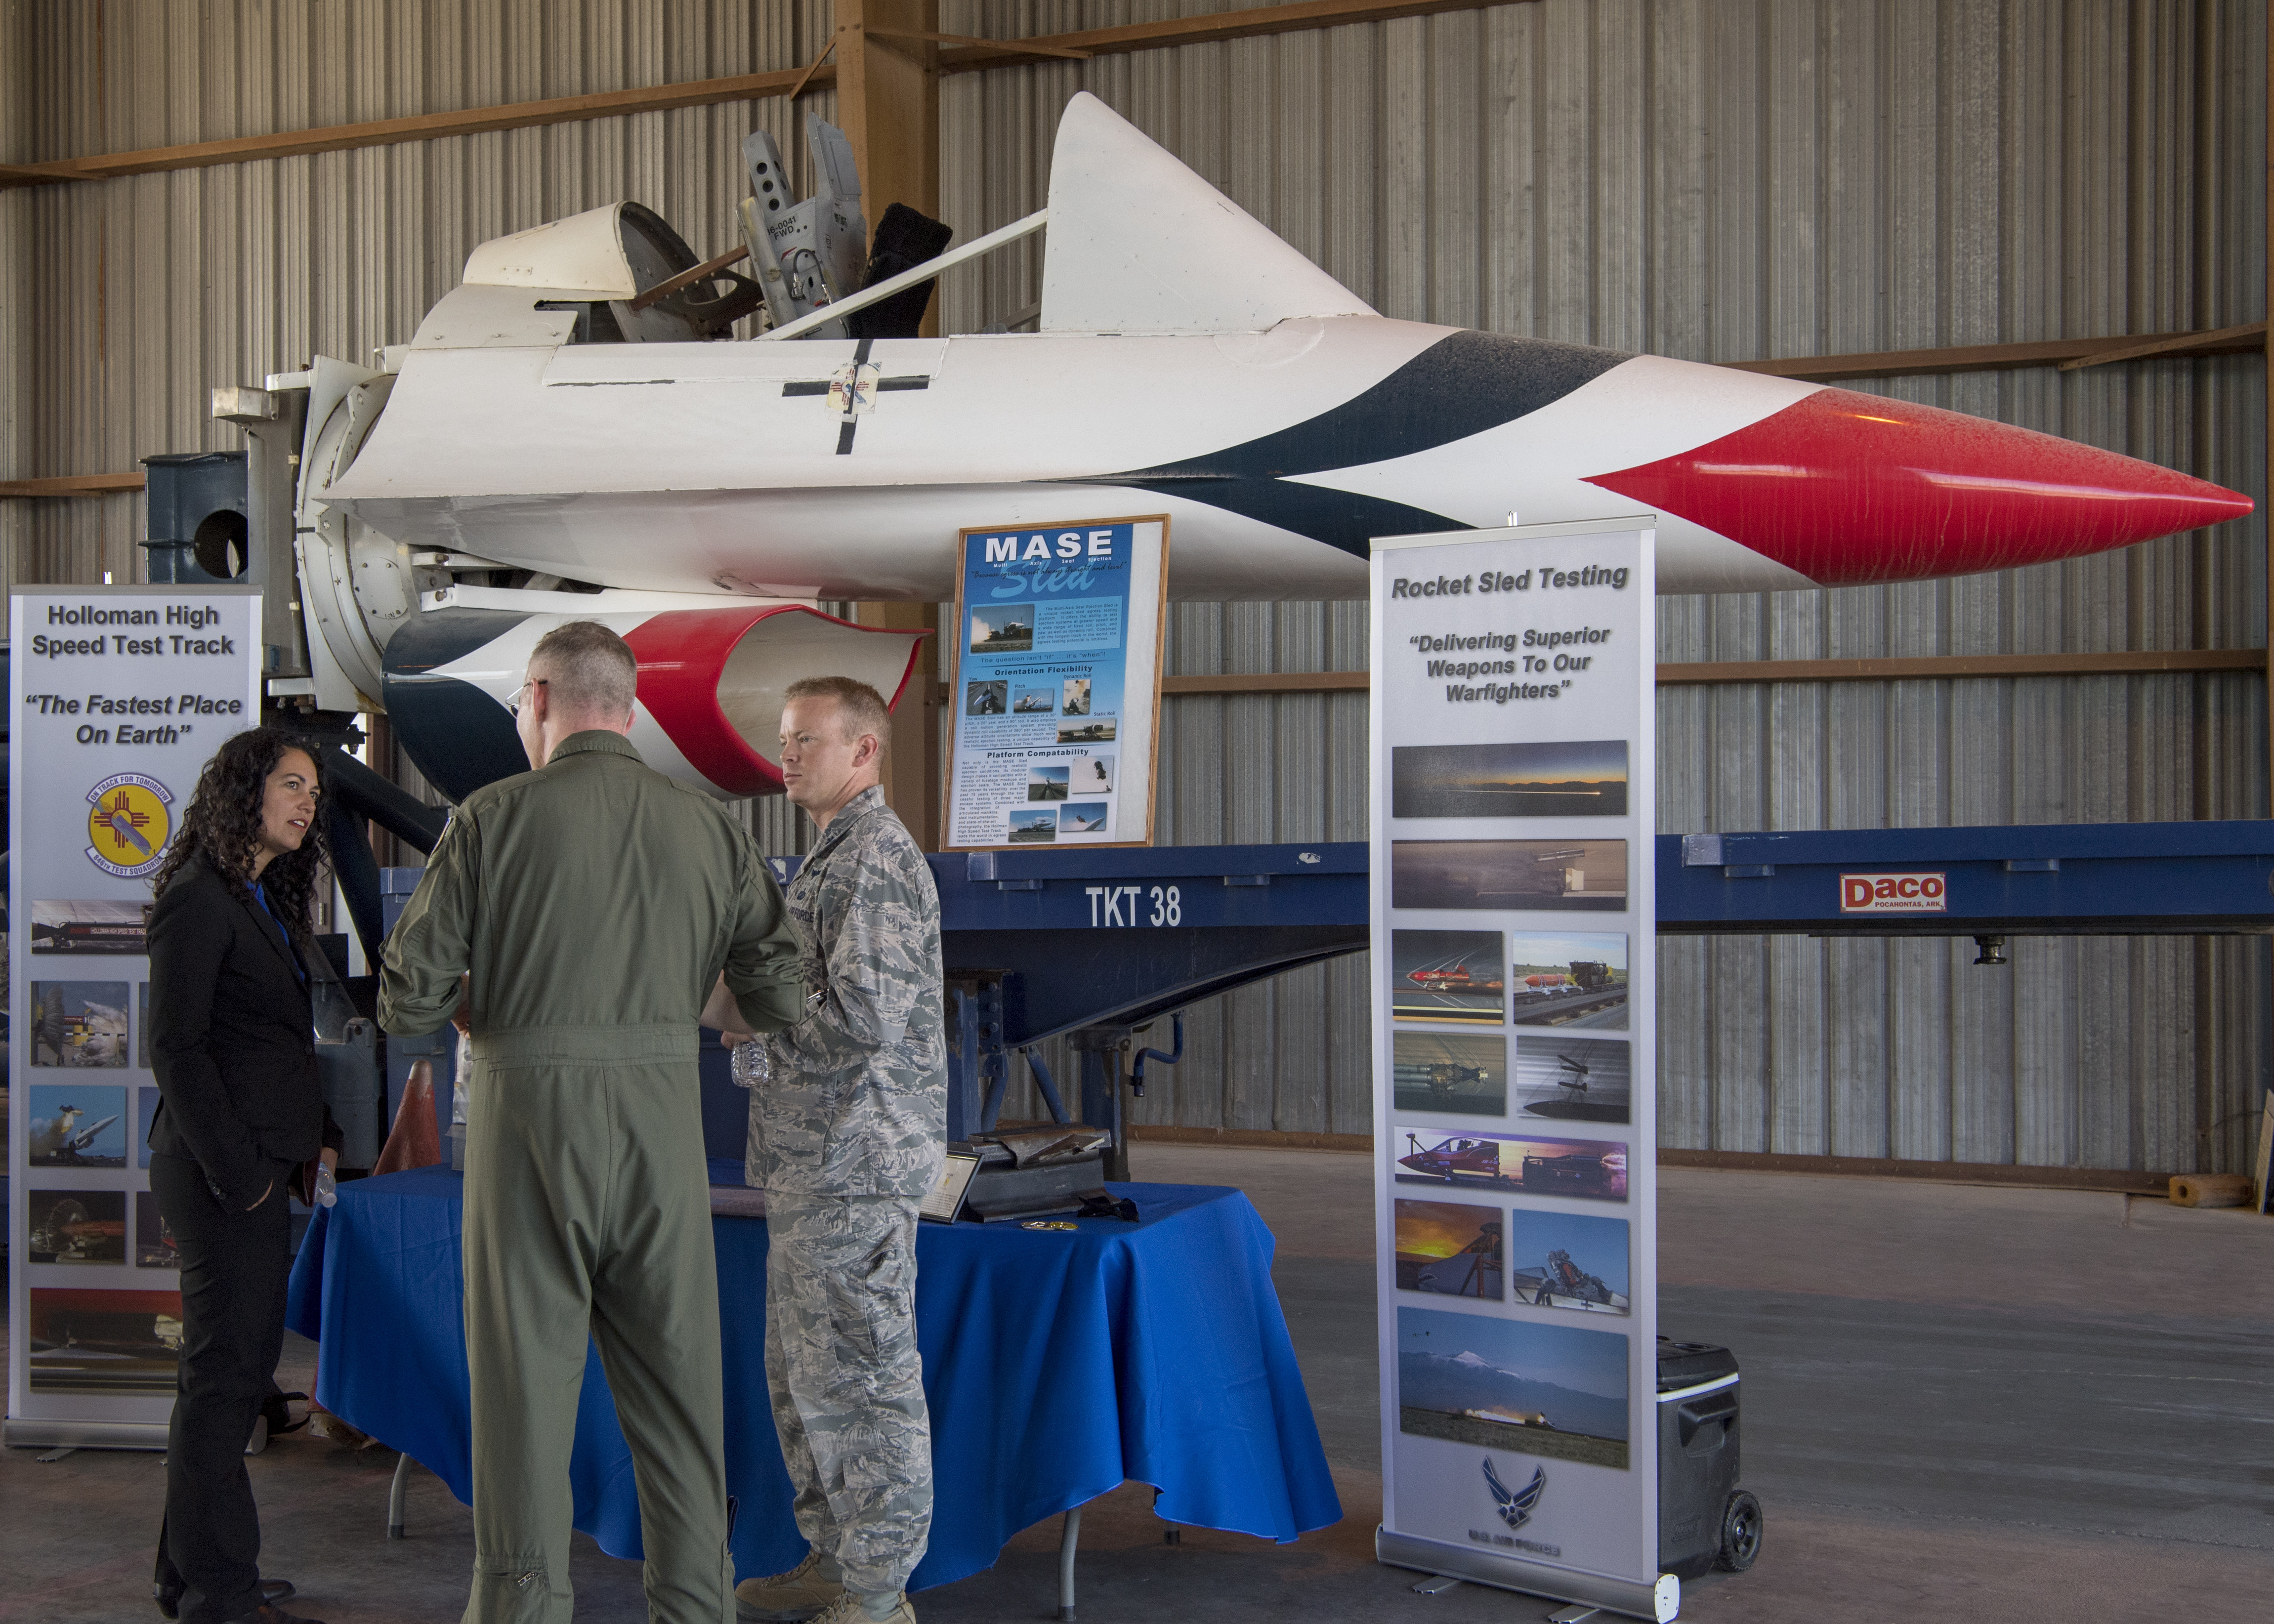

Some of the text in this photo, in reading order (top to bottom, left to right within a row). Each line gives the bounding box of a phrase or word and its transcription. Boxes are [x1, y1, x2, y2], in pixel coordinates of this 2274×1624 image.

[774, 226, 794, 240] FWD
[986, 530, 1112, 562] MASE
[1392, 565, 1628, 598] Rocket Sled Testing
[49, 606, 218, 629] Holloman High
[33, 635, 233, 659] Speed Test Track
[1410, 626, 1610, 652] “Delivering Superior
[995, 665, 1092, 676] Orientation Flexibility
[1428, 654, 1591, 679] Weapons To Our
[1447, 680, 1570, 704] Warfighters”
[26, 695, 242, 714] “The Fastest Place
[77, 725, 191, 744] On Earth”
[1027, 749, 1089, 757] Compatability
[90, 791, 99, 801] ON
[100, 778, 119, 792] TRACK
[136, 776, 169, 801] TOMORROW
[112, 866, 128, 875] TEST
[129, 855, 163, 874] SQUADRON
[1845, 877, 1943, 908] Daco
[1086, 886, 1180, 926] TKT 38
